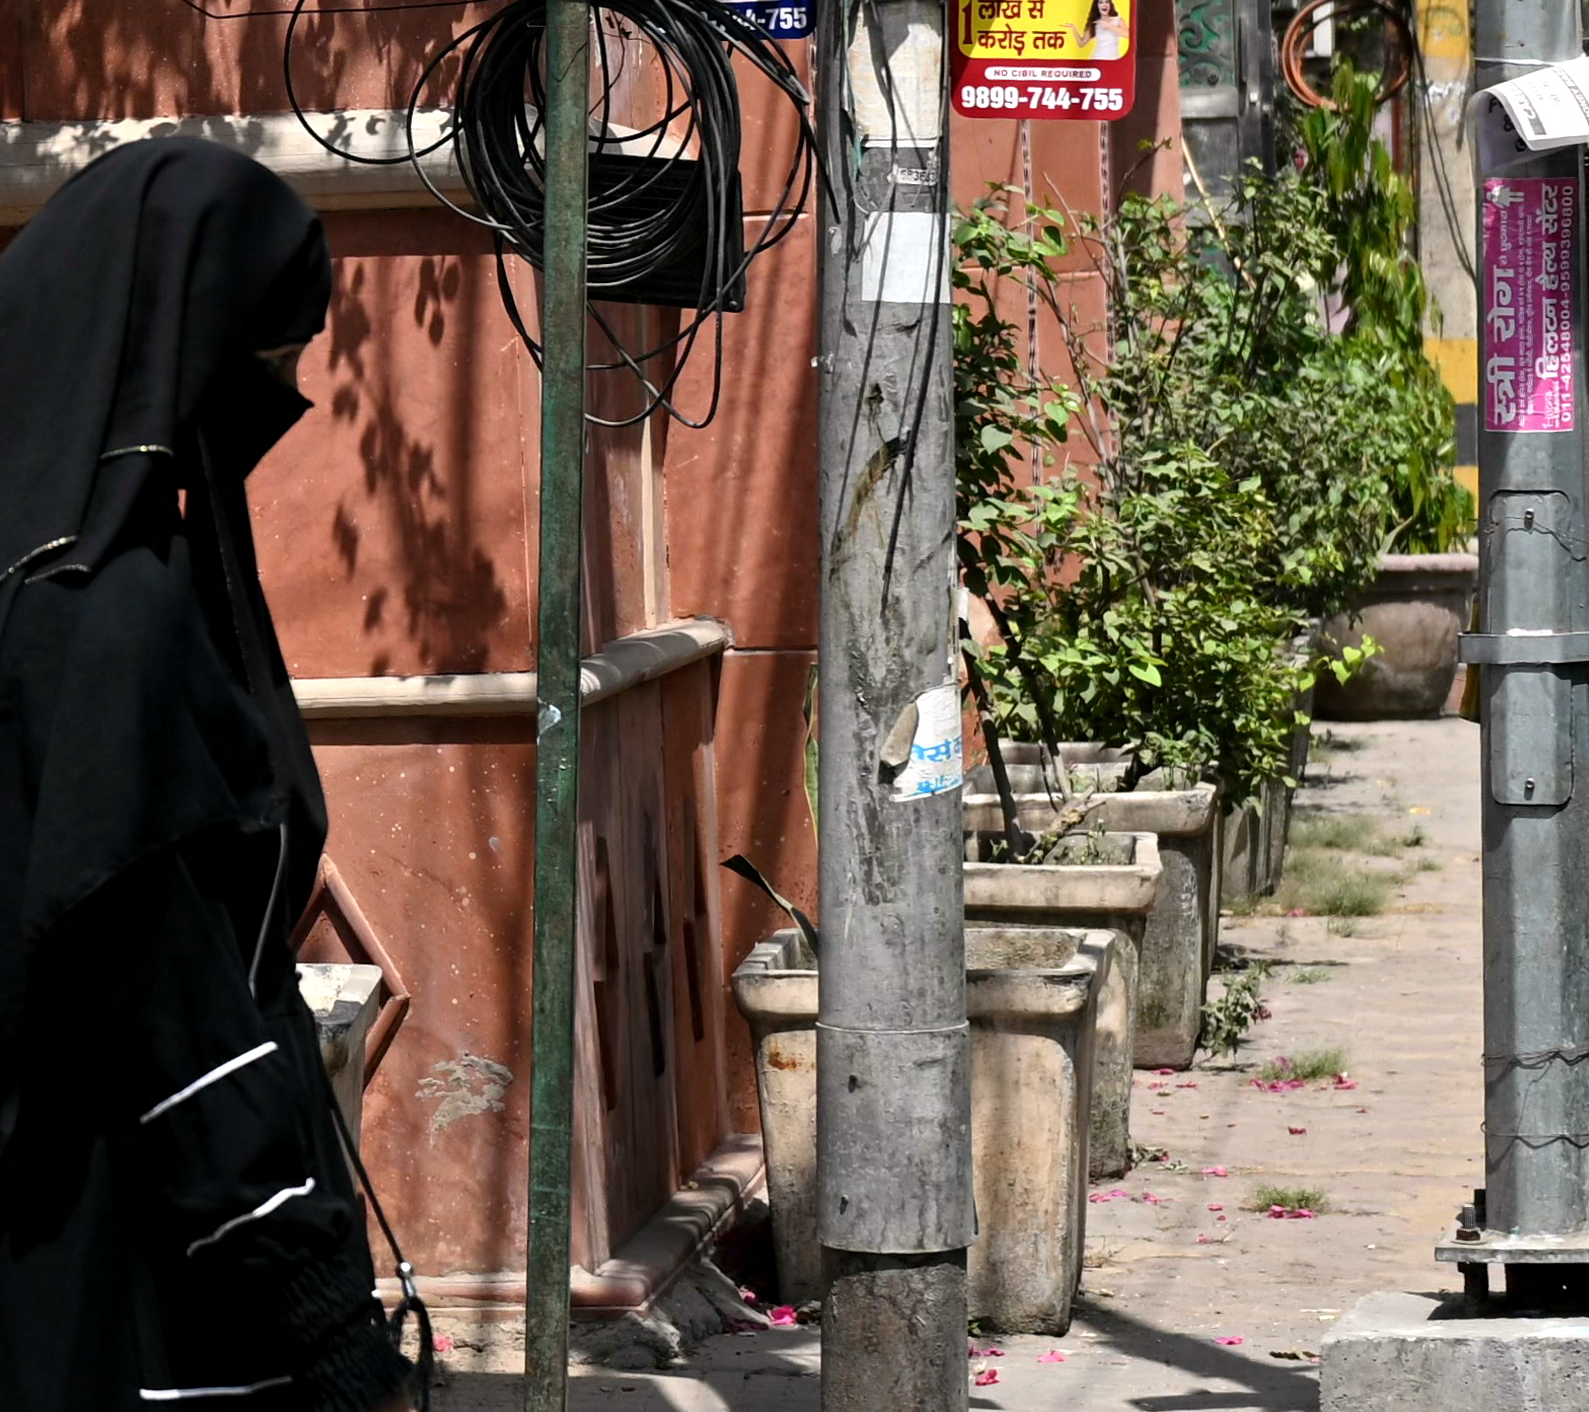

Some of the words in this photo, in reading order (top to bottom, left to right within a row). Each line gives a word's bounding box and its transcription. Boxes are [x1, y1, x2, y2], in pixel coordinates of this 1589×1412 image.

[962, 0, 972, 45] 1
[977, 0, 1021, 19] लाख
[977, 24, 1025, 56] करोड़
[1033, 31, 1066, 50] तक
[1011, 70, 1037, 78] CIBIL
[1041, 70, 1092, 78] REQUIRED
[962, 86, 1123, 110] 9899-744-755
[1487, 264, 1516, 343] रोग
[1535, 298, 1559, 380] हिलटन
[1487, 354, 1516, 426] स्त्री
